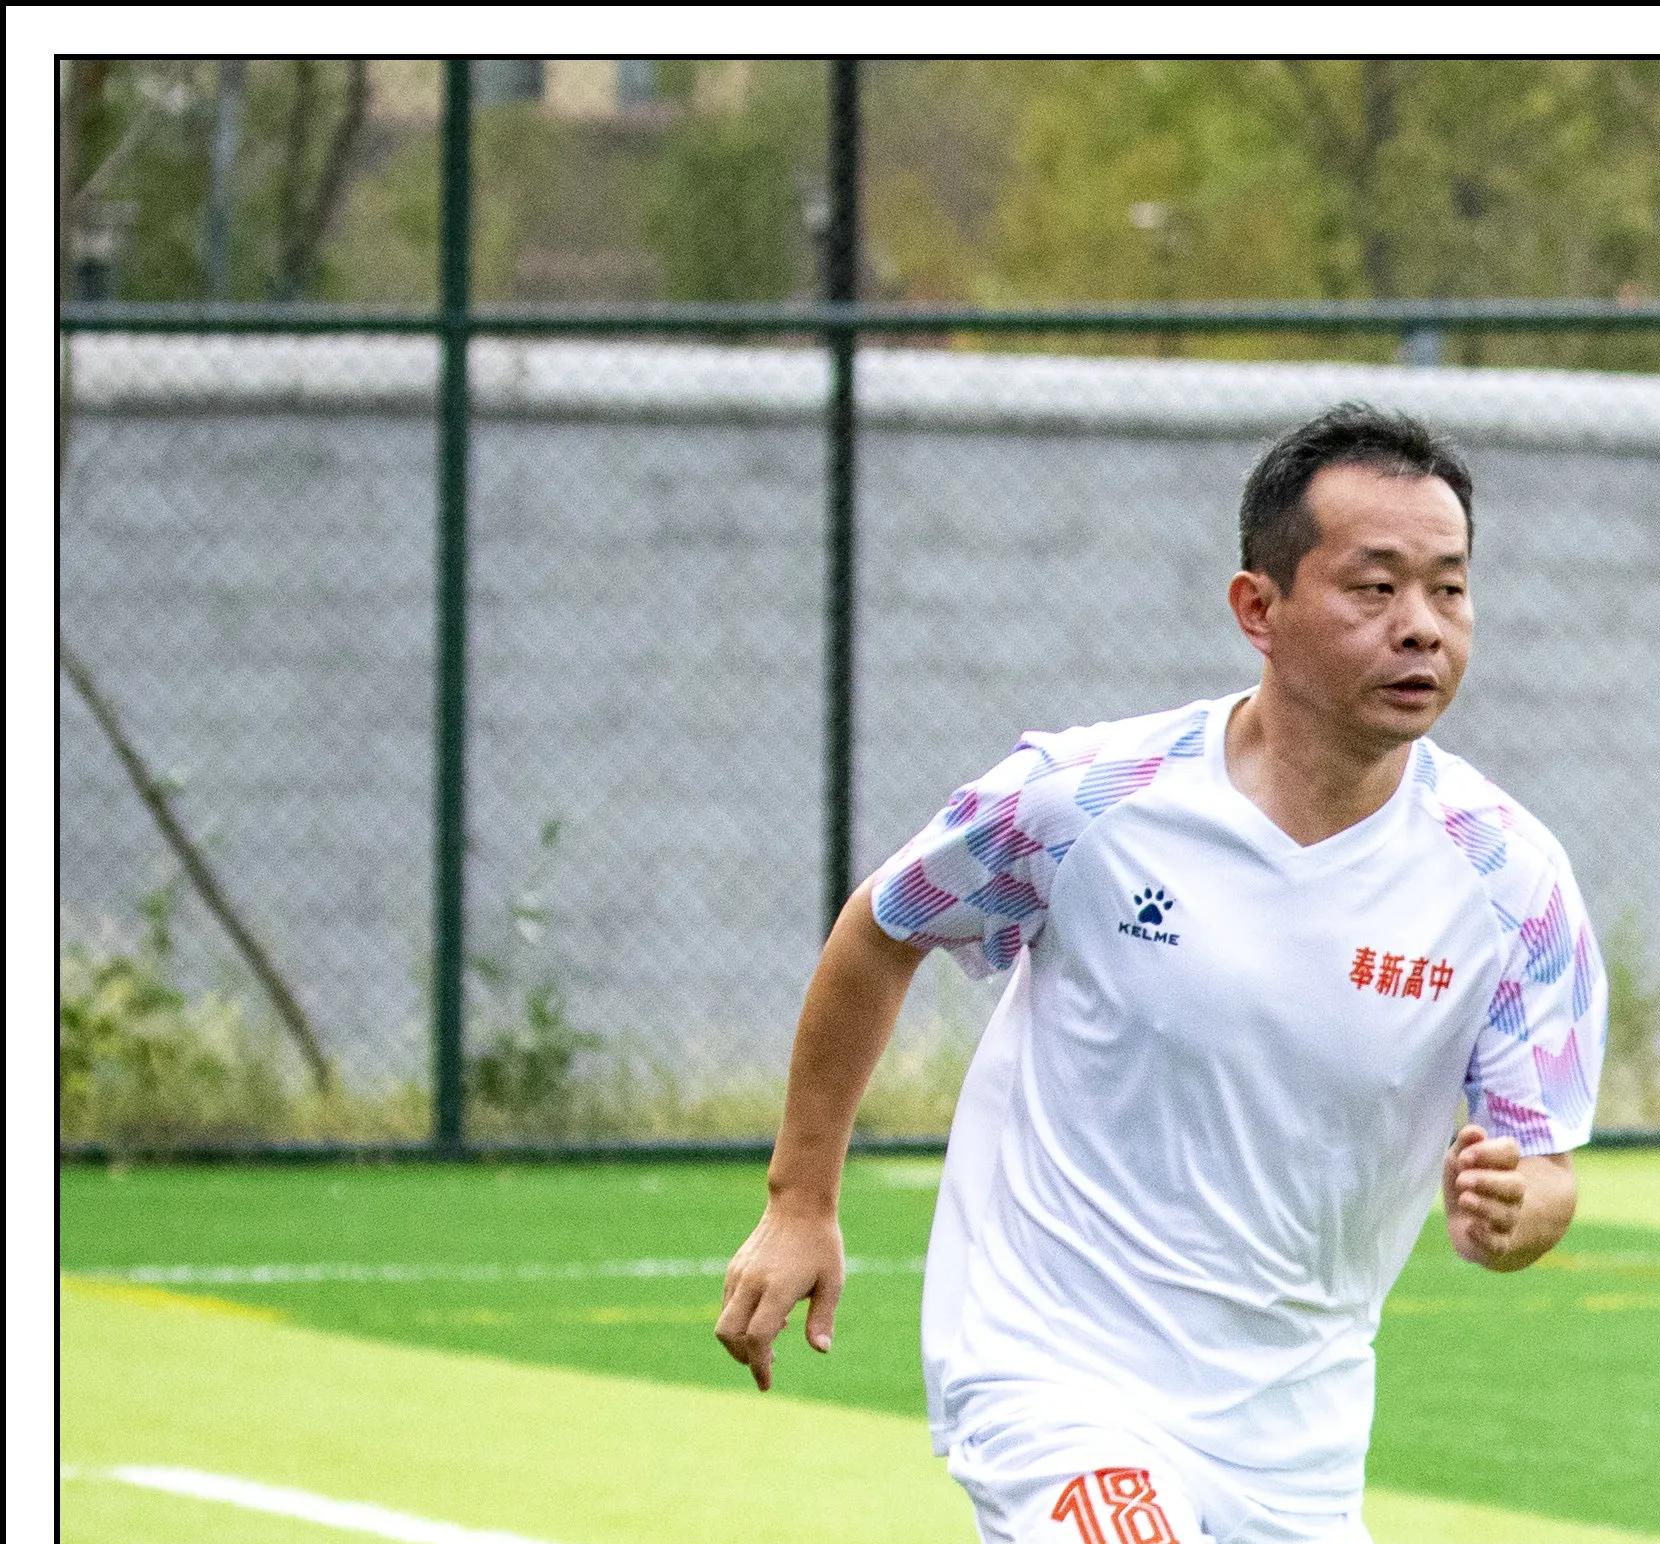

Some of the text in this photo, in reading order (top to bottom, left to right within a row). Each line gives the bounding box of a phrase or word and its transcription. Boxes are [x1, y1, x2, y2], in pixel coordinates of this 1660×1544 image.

[1118, 922, 1180, 946] KELME
[1348, 946, 1454, 1002] 奉新高中
